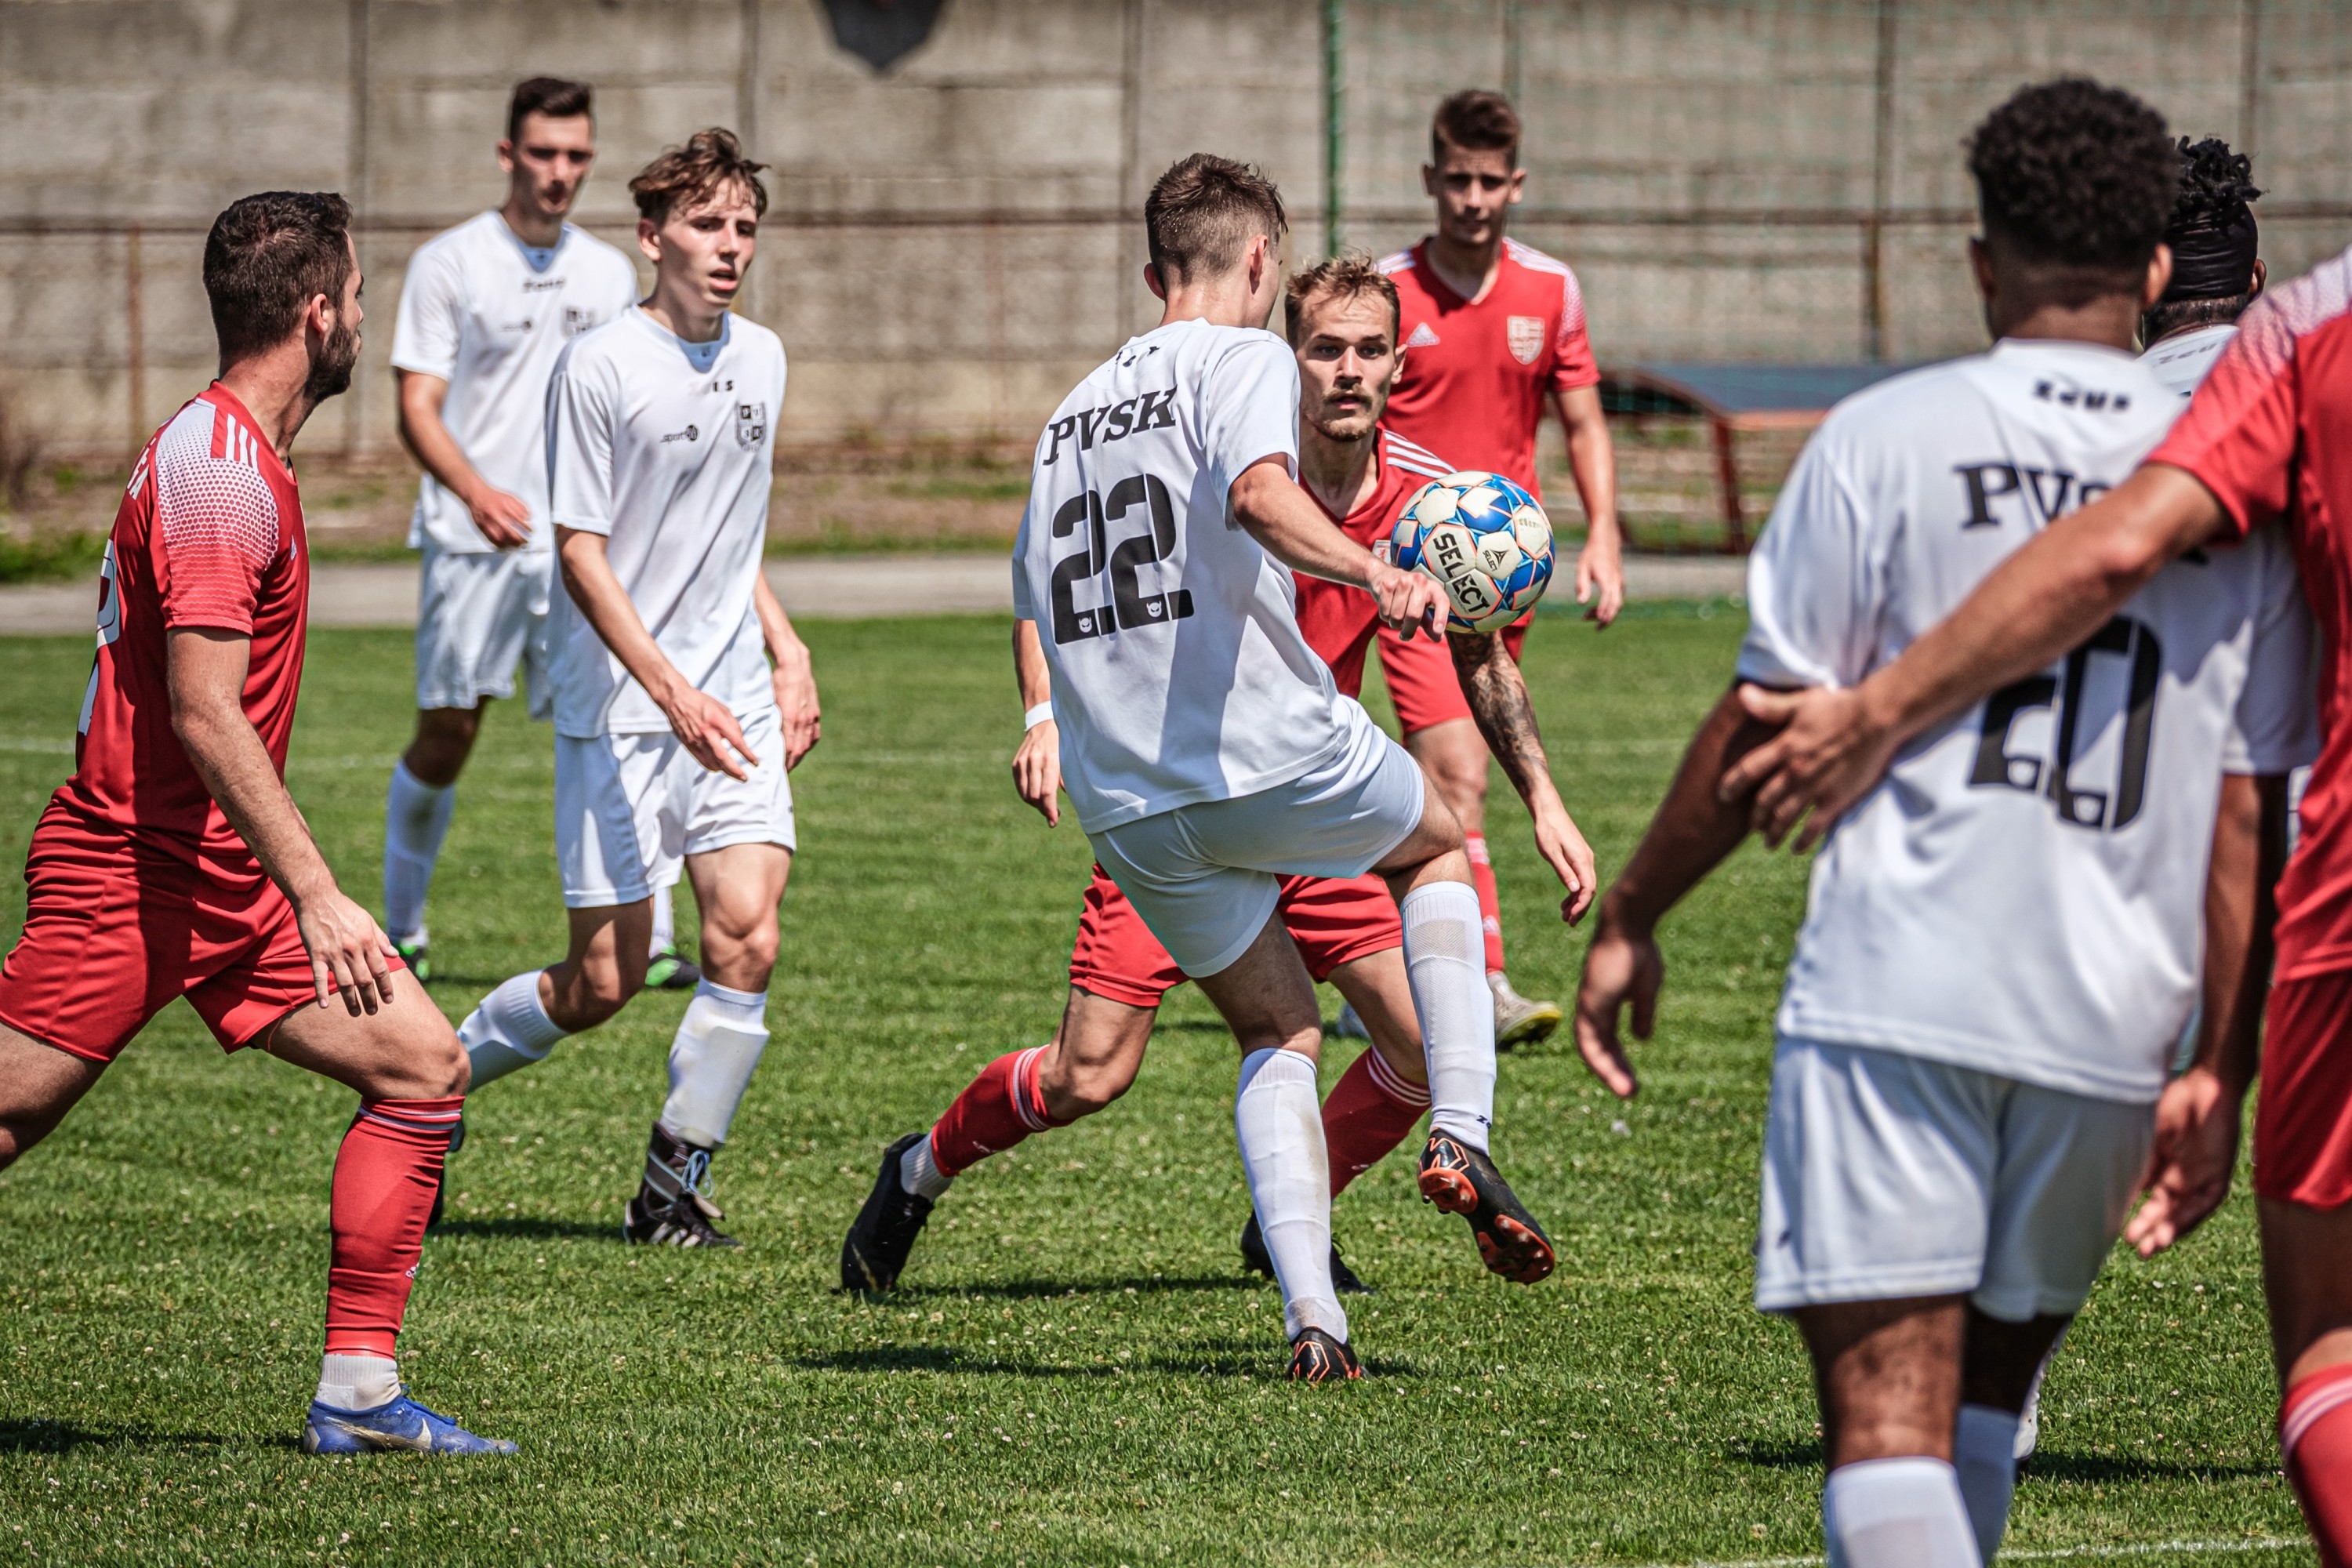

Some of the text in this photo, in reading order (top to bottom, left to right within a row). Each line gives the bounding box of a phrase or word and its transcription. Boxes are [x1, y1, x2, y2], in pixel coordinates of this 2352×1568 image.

[1044, 384, 1178, 466] PVSK
[1051, 474, 1194, 644] 22
[1433, 533, 1490, 613] SELECT
[1483, 550, 1497, 572] SELECT
[1966, 615, 2161, 833] 20
